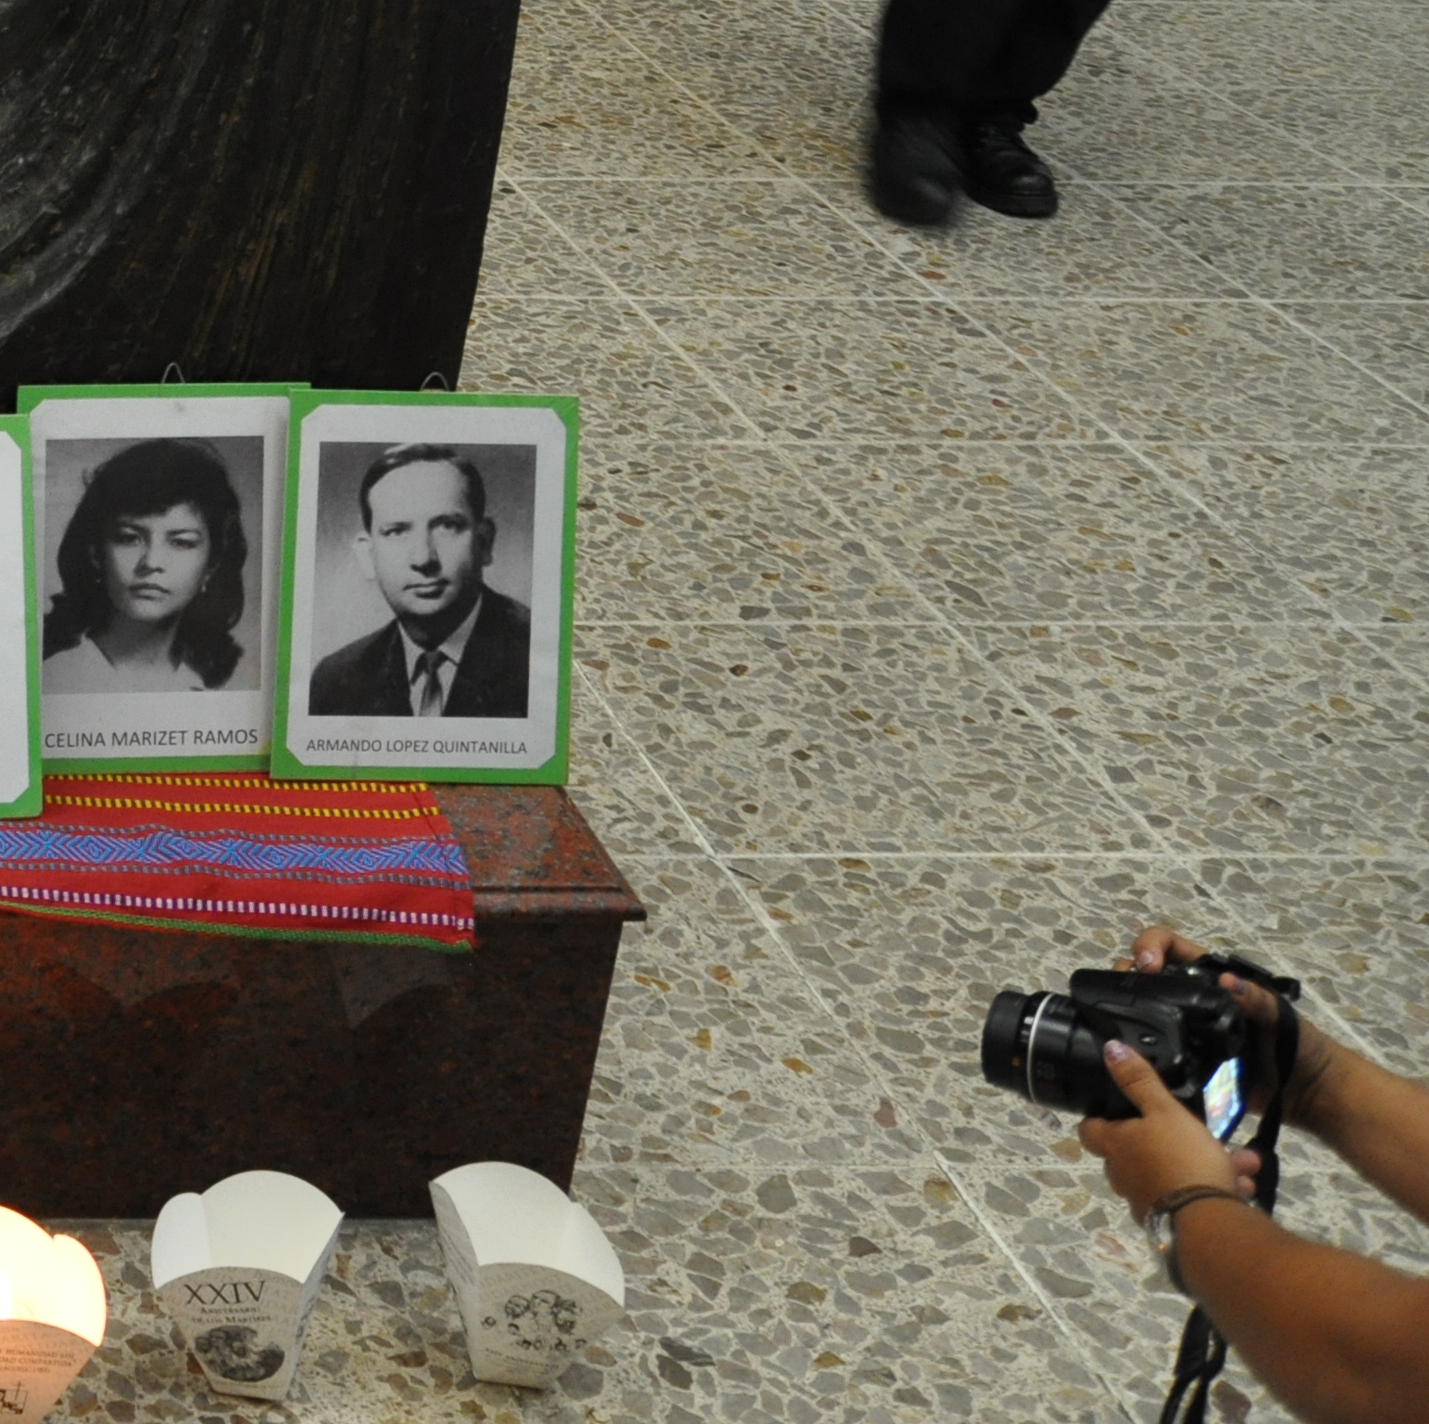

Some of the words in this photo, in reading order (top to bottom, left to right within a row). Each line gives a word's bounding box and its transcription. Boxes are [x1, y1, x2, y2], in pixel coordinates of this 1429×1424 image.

[45, 732, 106, 749] CELINA
[111, 730, 189, 747] MARIZET
[194, 728, 259, 746] RAMOS
[306, 739, 383, 752] ARMANDO
[386, 739, 429, 753] LOPEZ
[433, 740, 528, 755] QUINTANILLA
[184, 1280, 266, 1306] XXIV
